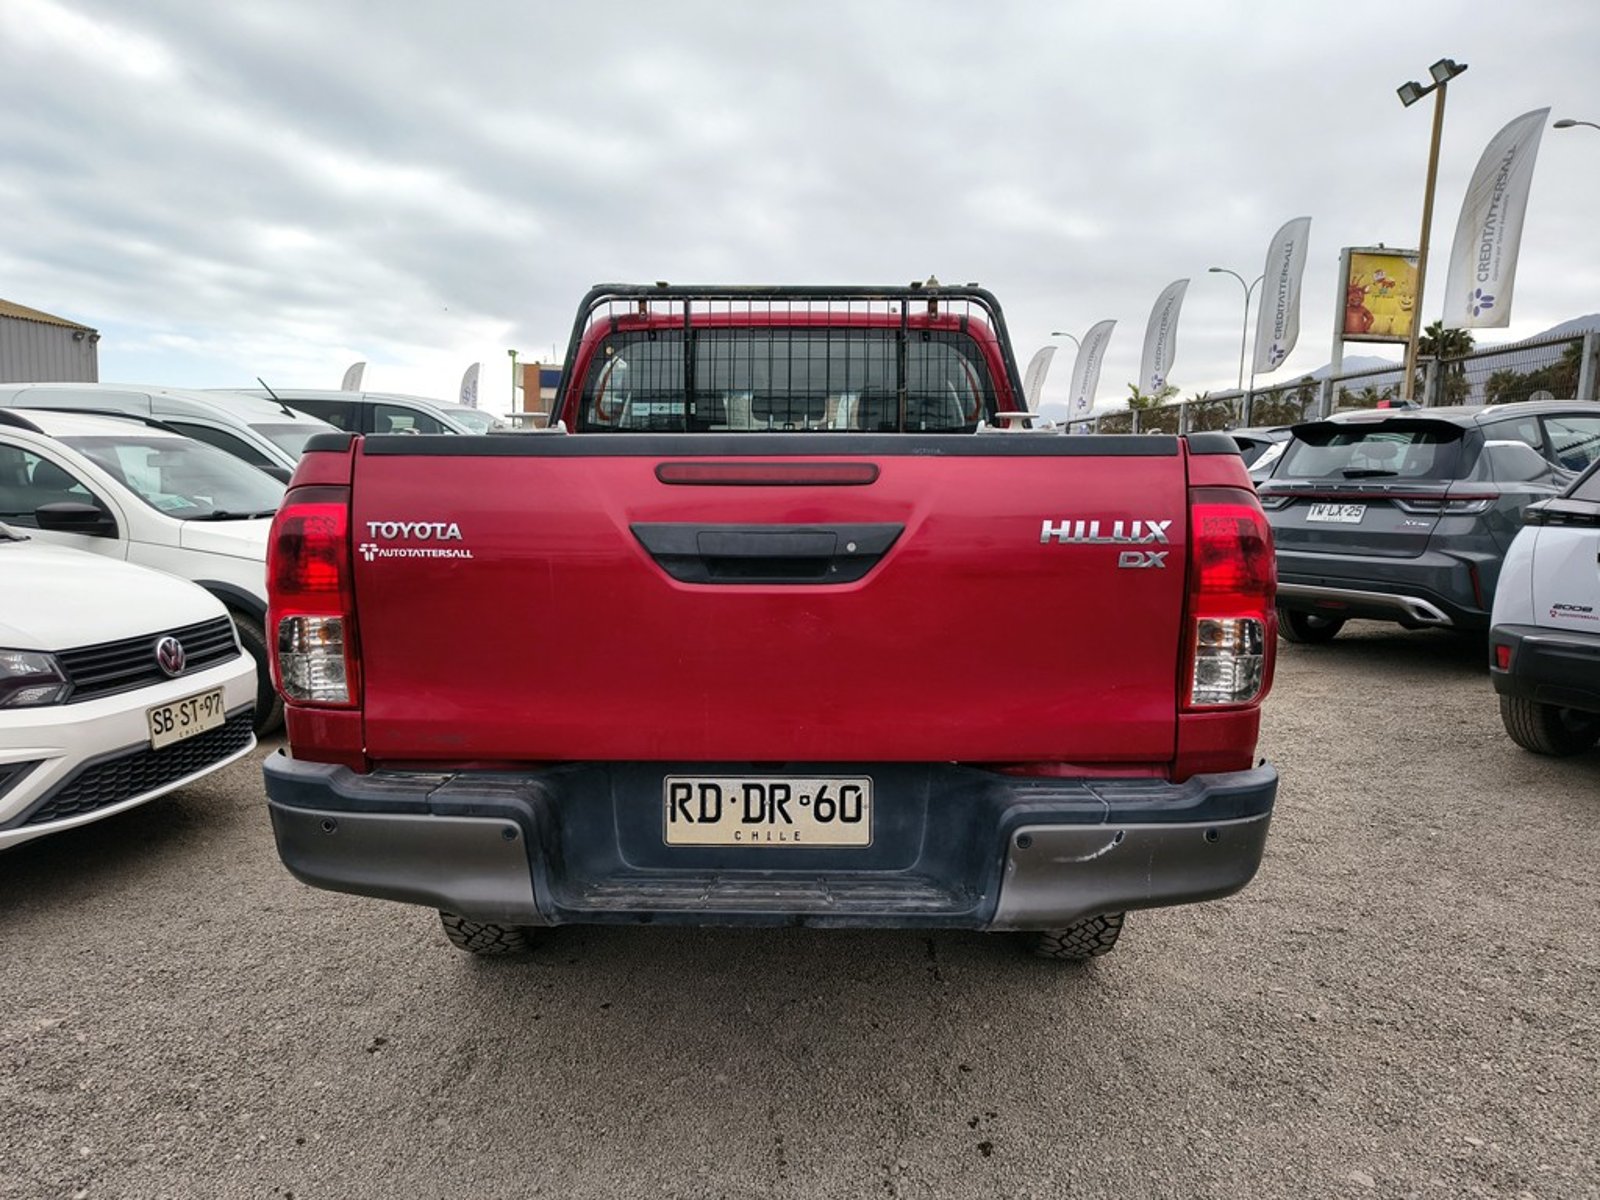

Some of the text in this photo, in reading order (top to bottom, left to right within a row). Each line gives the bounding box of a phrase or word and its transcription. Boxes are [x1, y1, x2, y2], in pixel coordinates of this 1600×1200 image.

[1476, 144, 1517, 282] CREDITATTERSALL
[1274, 240, 1294, 340] CREDITATTERSALL
[366, 521, 463, 540] TOYOTA
[1040, 519, 1172, 543] HILUX
[379, 548, 474, 559] AUTOTATTERSALL
[1118, 551, 1169, 568] DX
[734, 830, 801, 842] CHILE
